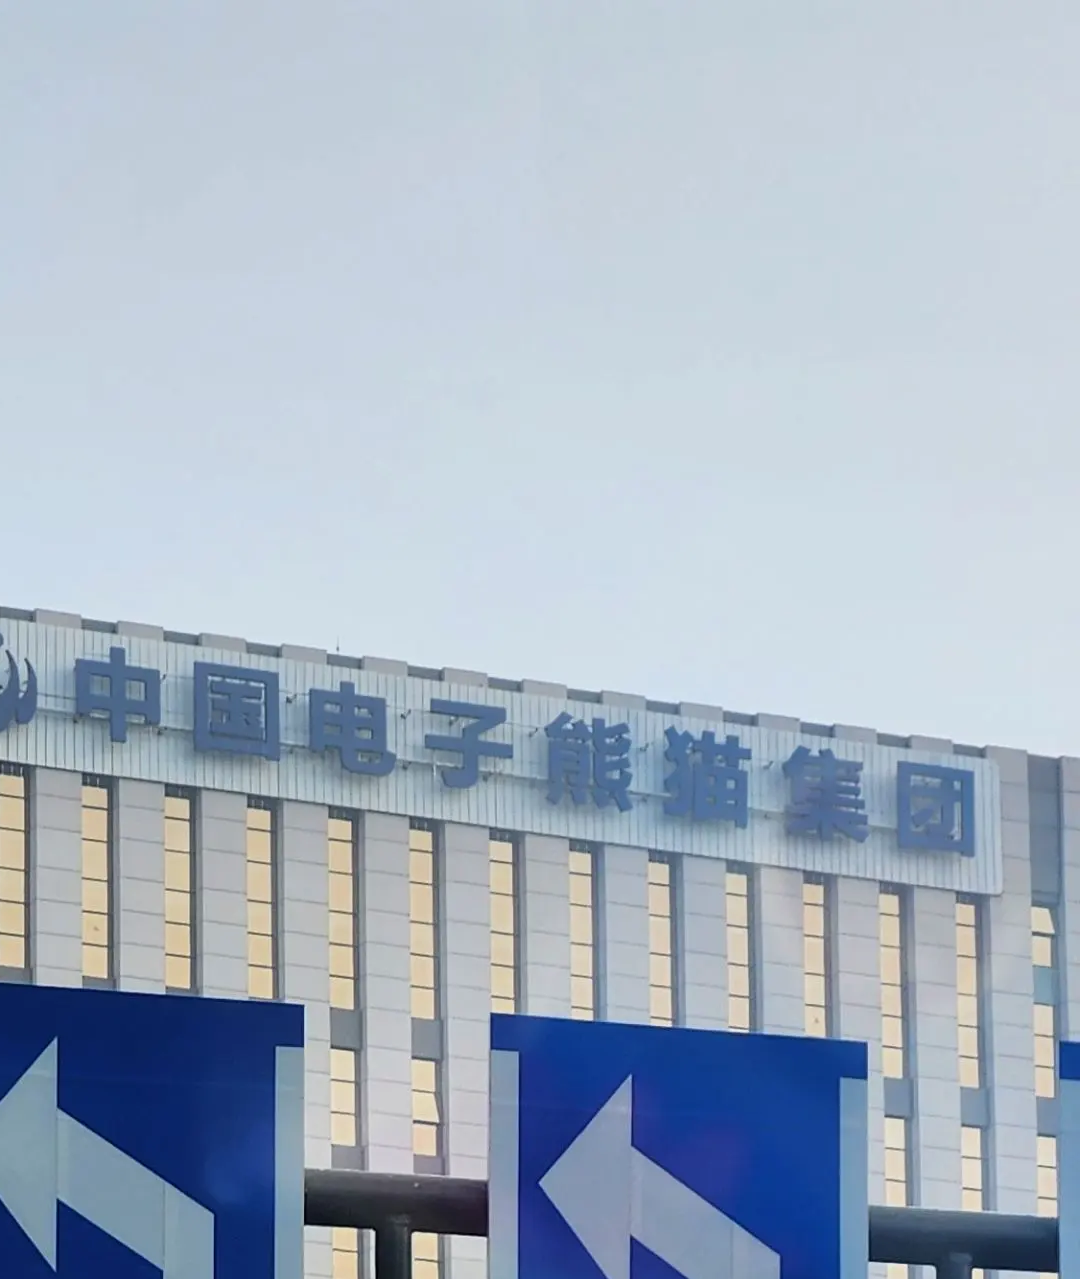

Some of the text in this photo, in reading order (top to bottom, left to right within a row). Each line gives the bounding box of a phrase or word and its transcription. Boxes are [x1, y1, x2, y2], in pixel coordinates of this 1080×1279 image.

[73, 647, 976, 858] 中国电子熊猫集团
